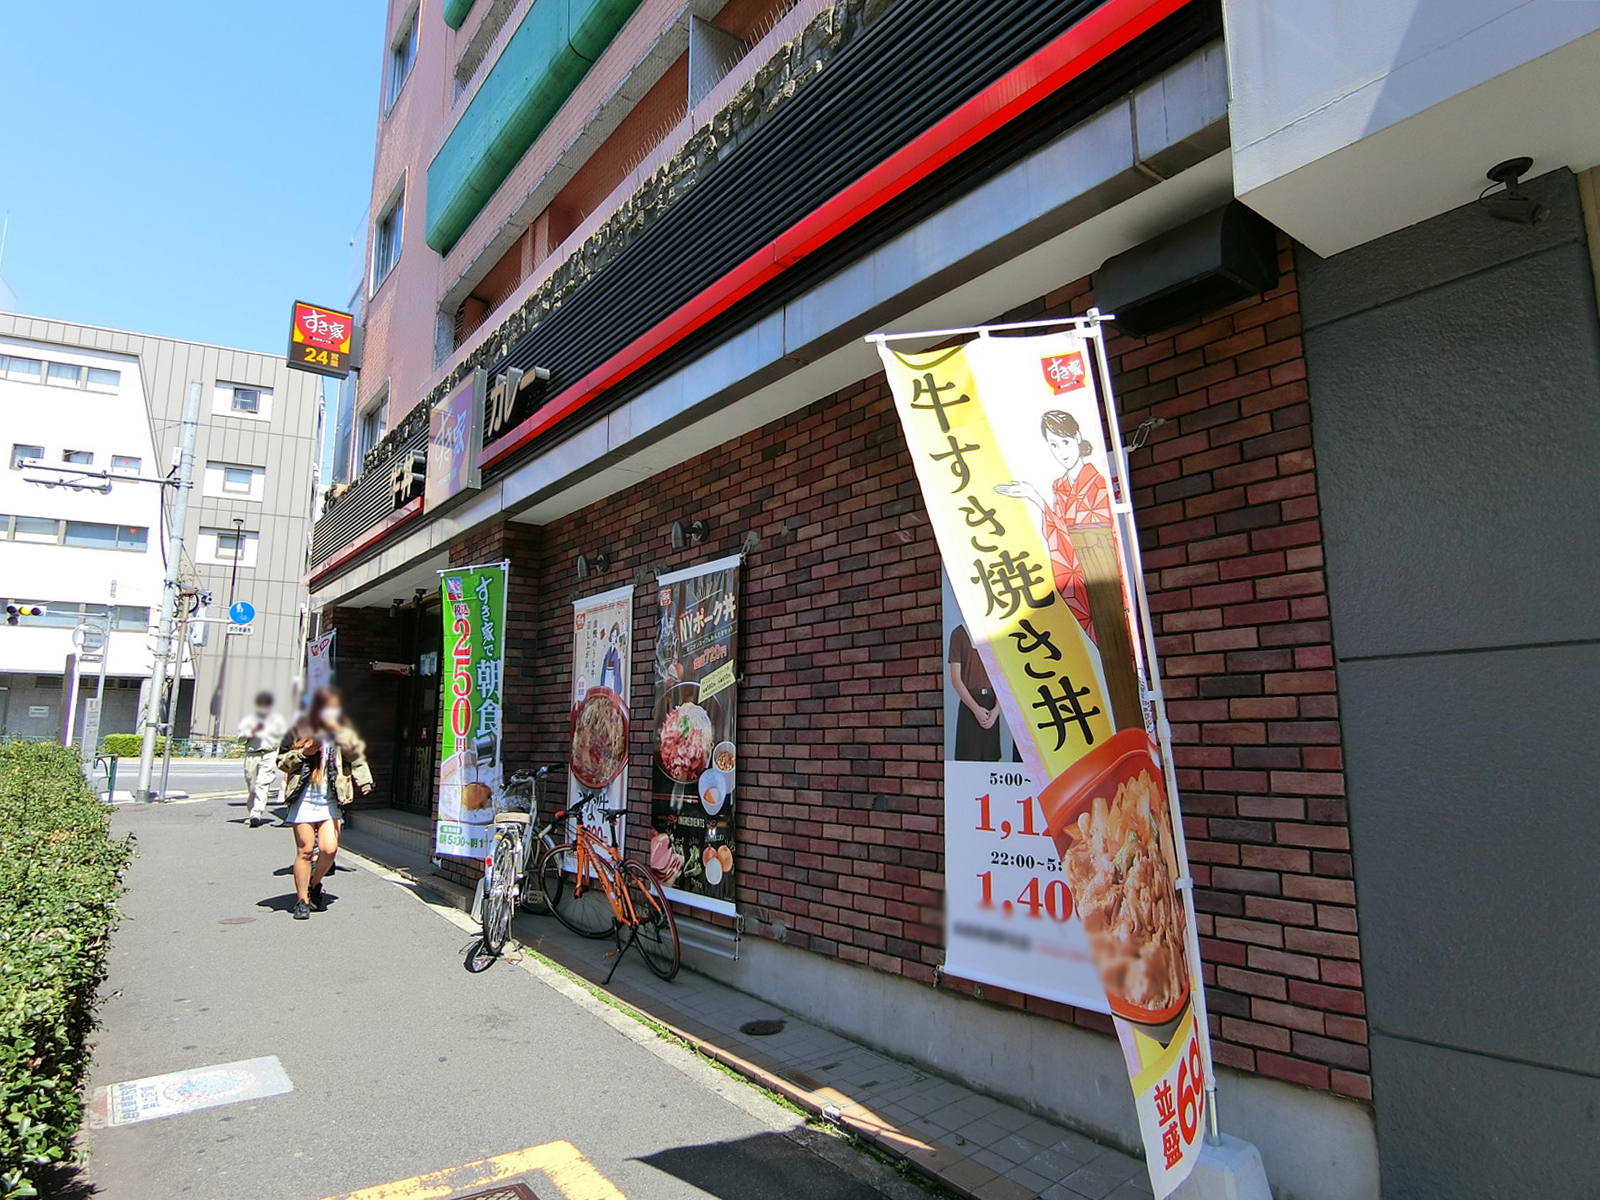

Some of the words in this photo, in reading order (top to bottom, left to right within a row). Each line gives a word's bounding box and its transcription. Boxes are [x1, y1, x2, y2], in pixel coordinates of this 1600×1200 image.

[302, 309, 345, 340] すき家
[304, 347, 328, 365] 24
[1047, 358, 1083, 382] すき家
[488, 367, 548, 437] カレー
[433, 409, 467, 470] すき家
[910, 373, 1100, 752] 牛すき焼き丼
[679, 592, 737, 644] NYポーク丼
[974, 793, 1052, 840] 1,1
[1154, 1079, 1183, 1171] 並盛
